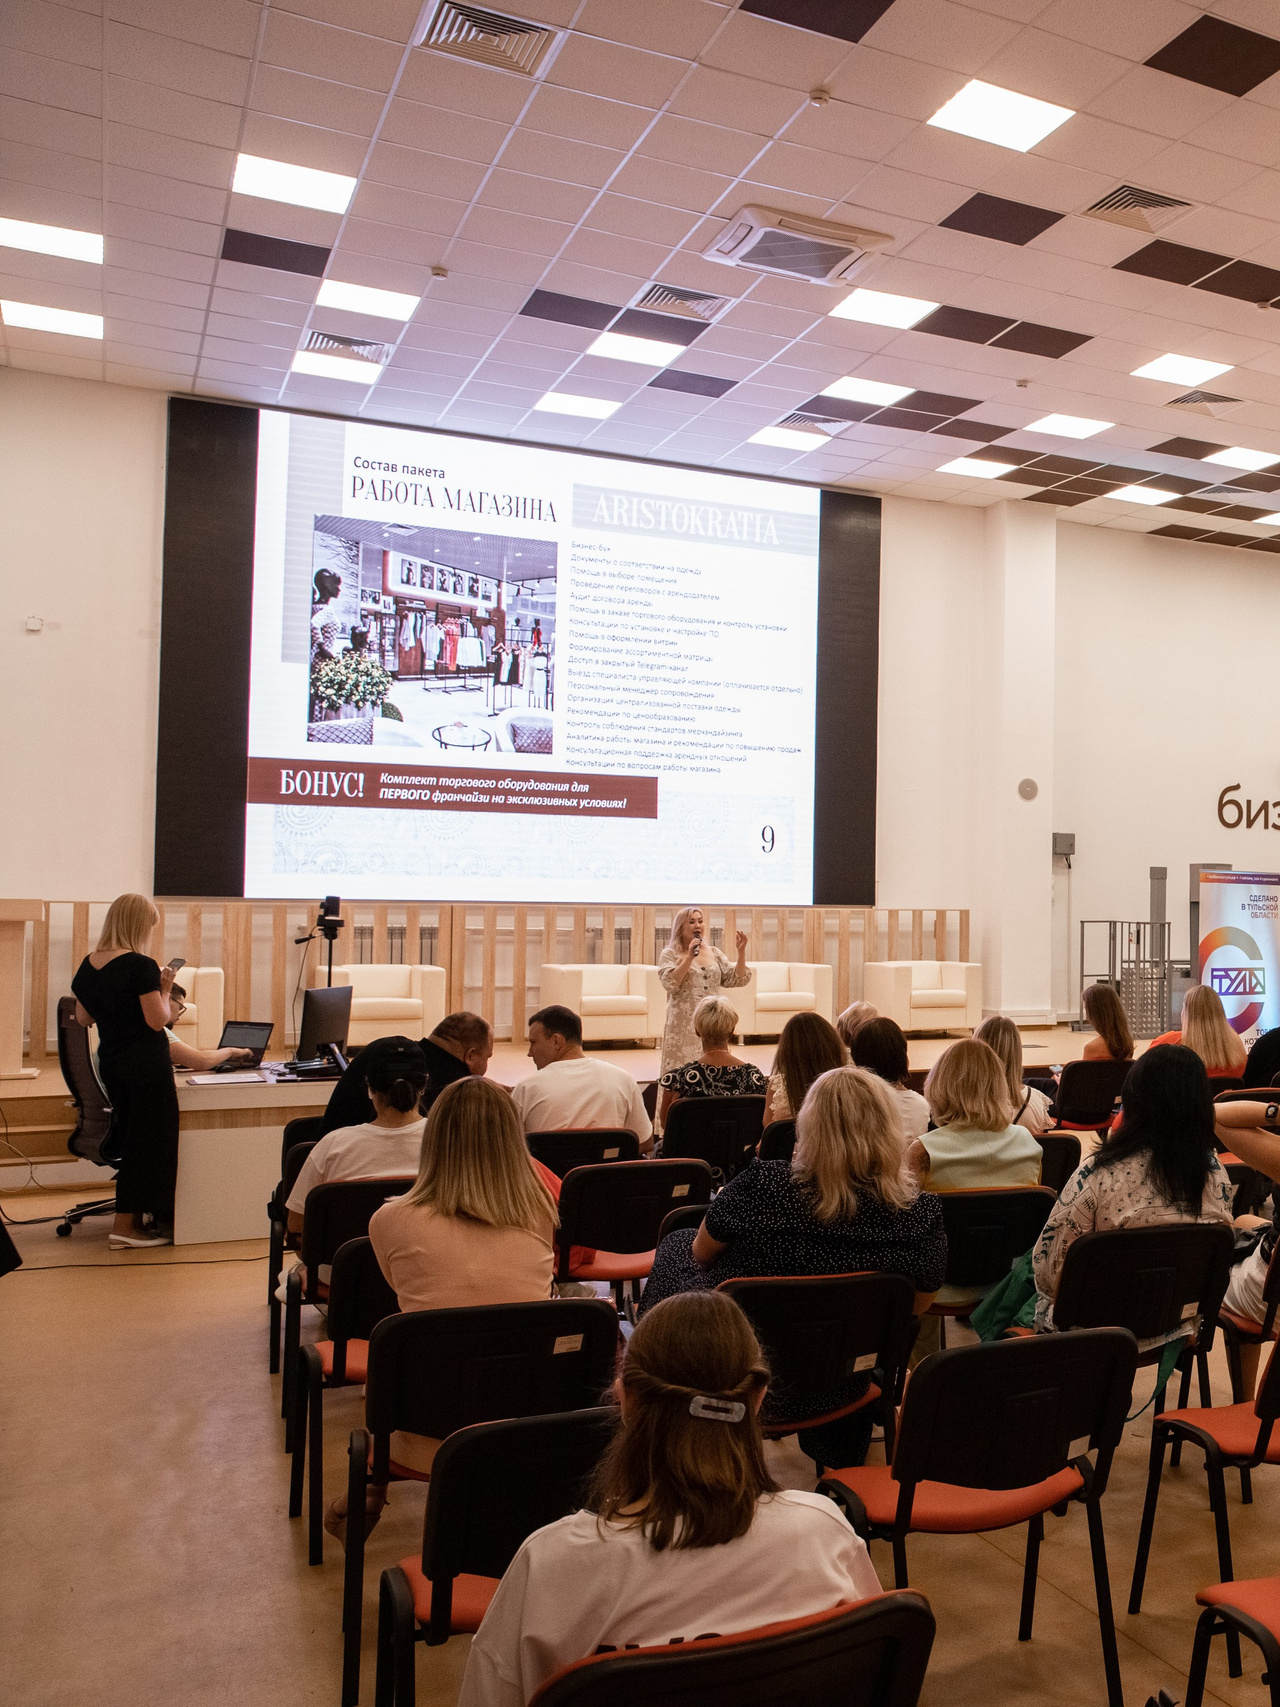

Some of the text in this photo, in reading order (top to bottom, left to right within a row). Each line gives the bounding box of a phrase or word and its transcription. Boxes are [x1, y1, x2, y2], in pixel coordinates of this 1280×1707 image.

[354, 456, 445, 479] Состав пакета
[351, 475, 558, 523] РАБОТА МАГАЗИНА
[591, 493, 780, 545] ARISTOKRATIA
[571, 554, 611, 564] Документы
[620, 561, 664, 570] соответствии
[676, 567, 702, 576] одежду
[570, 566, 600, 576] Помощь
[609, 571, 635, 580] выборе
[637, 575, 678, 584] помещения
[570, 578, 614, 590] Проведение
[616, 585, 660, 595] переговоров
[668, 590, 720, 600] арендодателем
[570, 592, 590, 600] Аудит
[592, 595, 625, 604] договора
[570, 604, 600, 614] Помощь
[632, 612, 666, 620] торгового
[668, 614, 716, 625] оборудования
[755, 624, 788, 632] установки
[570, 618, 618, 628] Консультации
[630, 624, 664, 633] установке
[673, 628, 708, 637] настройке
[569, 630, 599, 640] Помощь
[607, 634, 652, 644] оформлении
[654, 638, 678, 646] витрин
[568, 643, 624, 654] Формирование
[625, 648, 682, 659] ассортиментной
[568, 656, 593, 665] Доступ
[601, 660, 635, 668] закрытый
[637, 660, 688, 672] Telegram-канал
[568, 668, 590, 678] Выезд
[592, 672, 636, 680] специалиста
[638, 675, 686, 684] управляющей
[568, 681, 714, 698] Персональный менеджер сопровождения
[568, 694, 614, 704] Организация
[616, 700, 681, 709] централизованной
[568, 707, 620, 718] Рекомендации
[602, 722, 646, 731] соблюдения
[648, 726, 686, 734] стандартов
[688, 728, 742, 738] мерчандайзинга
[566, 733, 604, 742] Аналитика
[606, 735, 632, 744] работы
[634, 738, 666, 746] магазина
[674, 740, 724, 749] рекомендации
[736, 744, 776, 752] повышению
[777, 746, 802, 754] продаж
[566, 746, 747, 762] Консультационная поддержка арендных отношений
[566, 760, 616, 768] Консультации
[663, 764, 688, 772] работы
[280, 770, 365, 798] БОНУС!
[380, 773, 590, 794] Комплект торгового оборудования для
[379, 787, 627, 810] ПЕРВОГО франчайзи на эксклюзивных условиях!
[762, 825, 775, 854] 9
[1249, 894, 1278, 902] СДЕЛАНО
[1247, 903, 1278, 911] ТУЛЬСКОЙ
